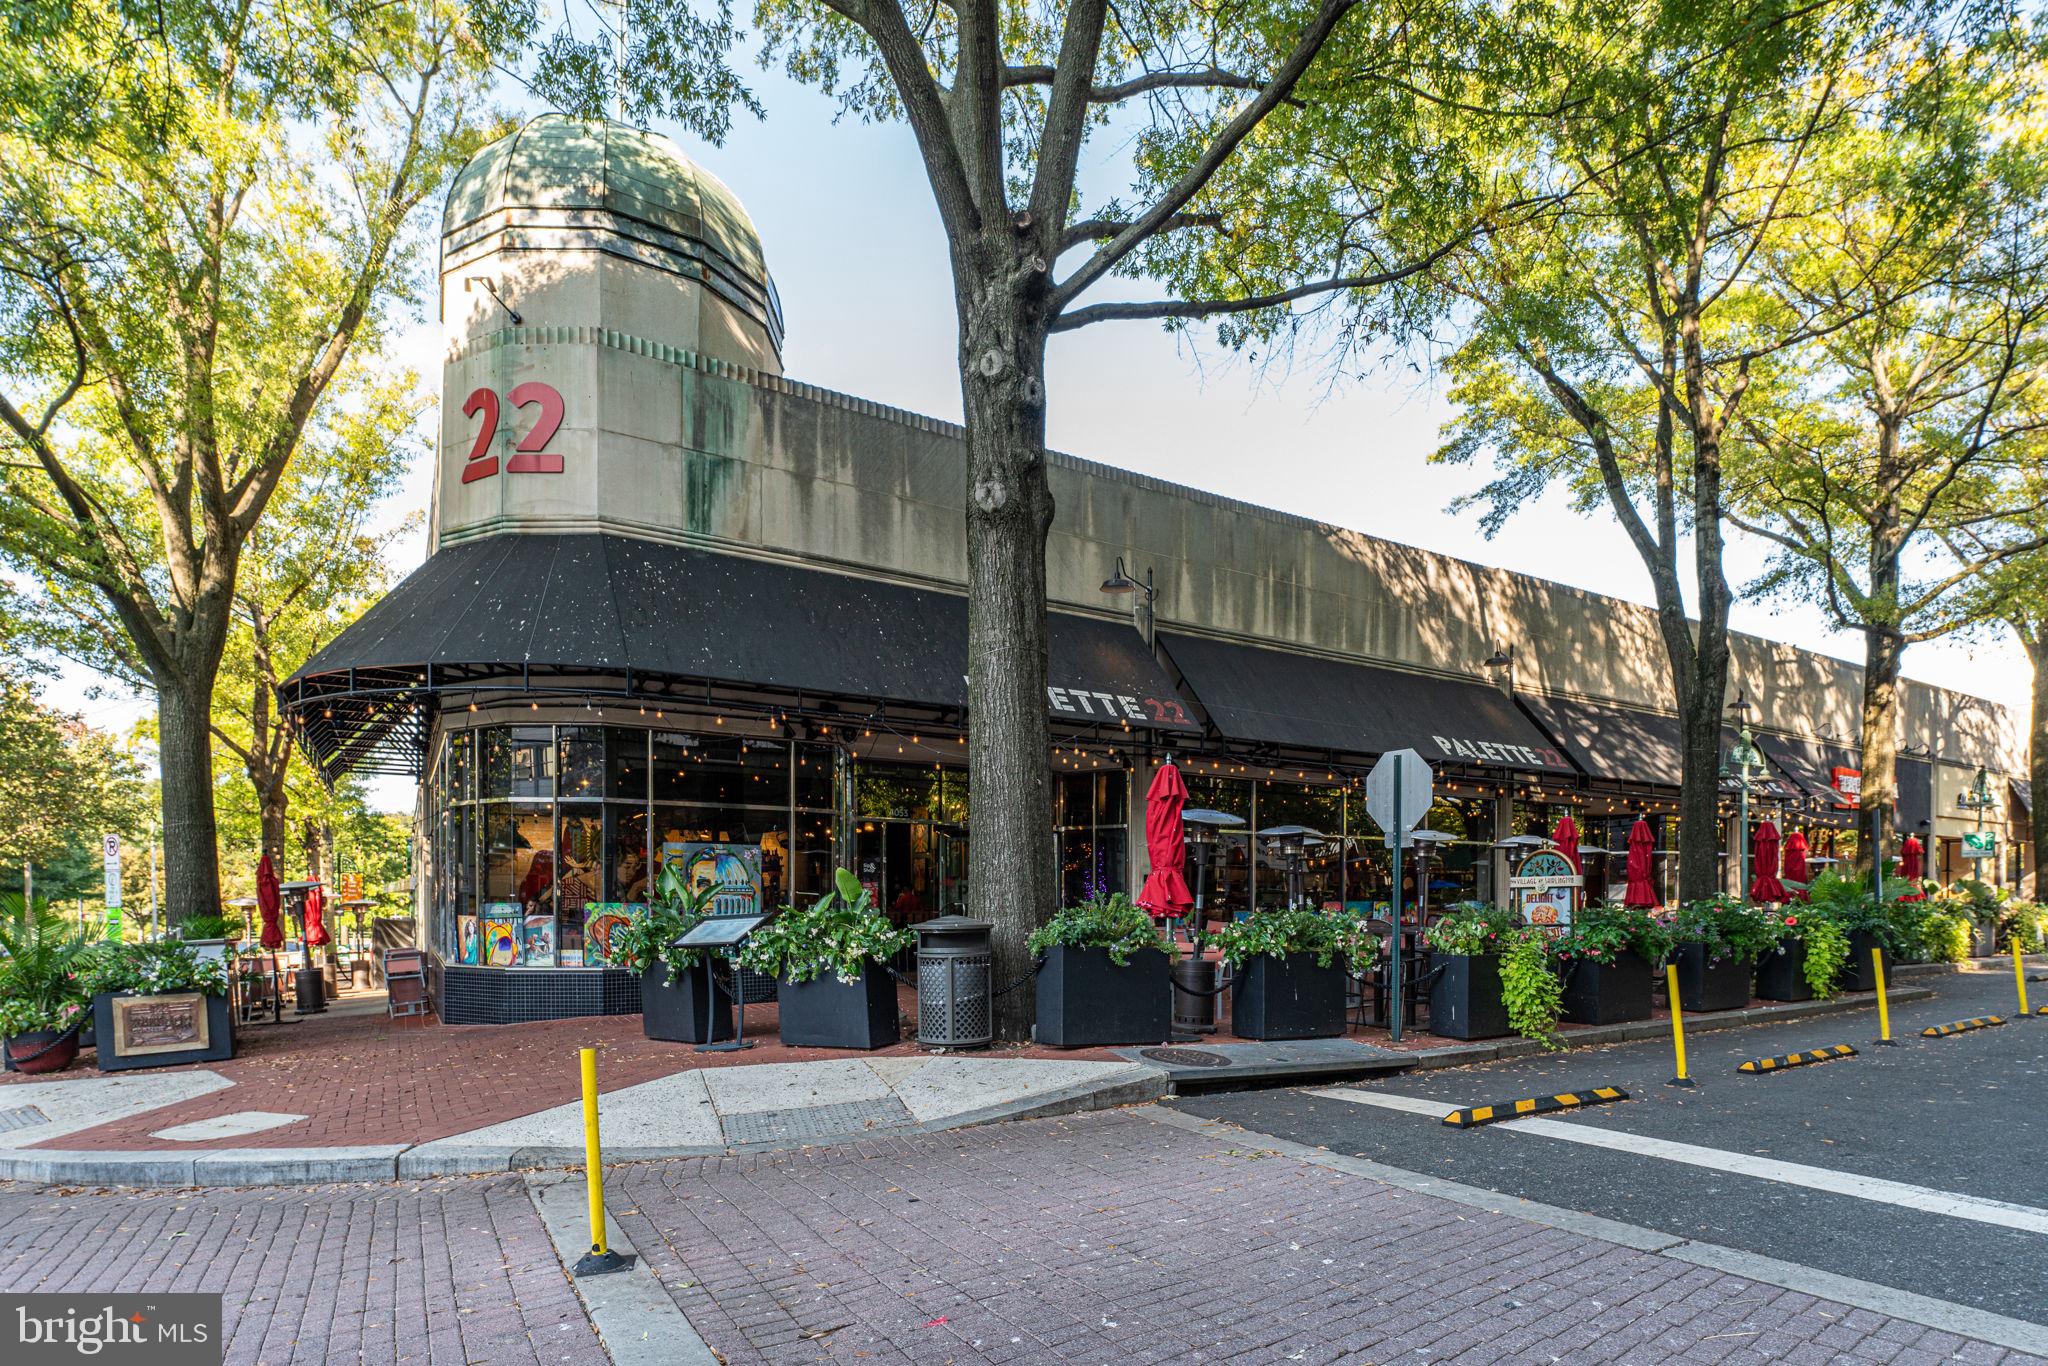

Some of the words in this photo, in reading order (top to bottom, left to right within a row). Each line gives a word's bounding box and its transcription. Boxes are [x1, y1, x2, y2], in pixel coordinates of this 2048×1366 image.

[462, 381, 565, 485] 22
[1144, 697, 1191, 725] 22
[1432, 735, 1543, 765] PALETTE
[1526, 893, 1553, 903] DELIGHT
